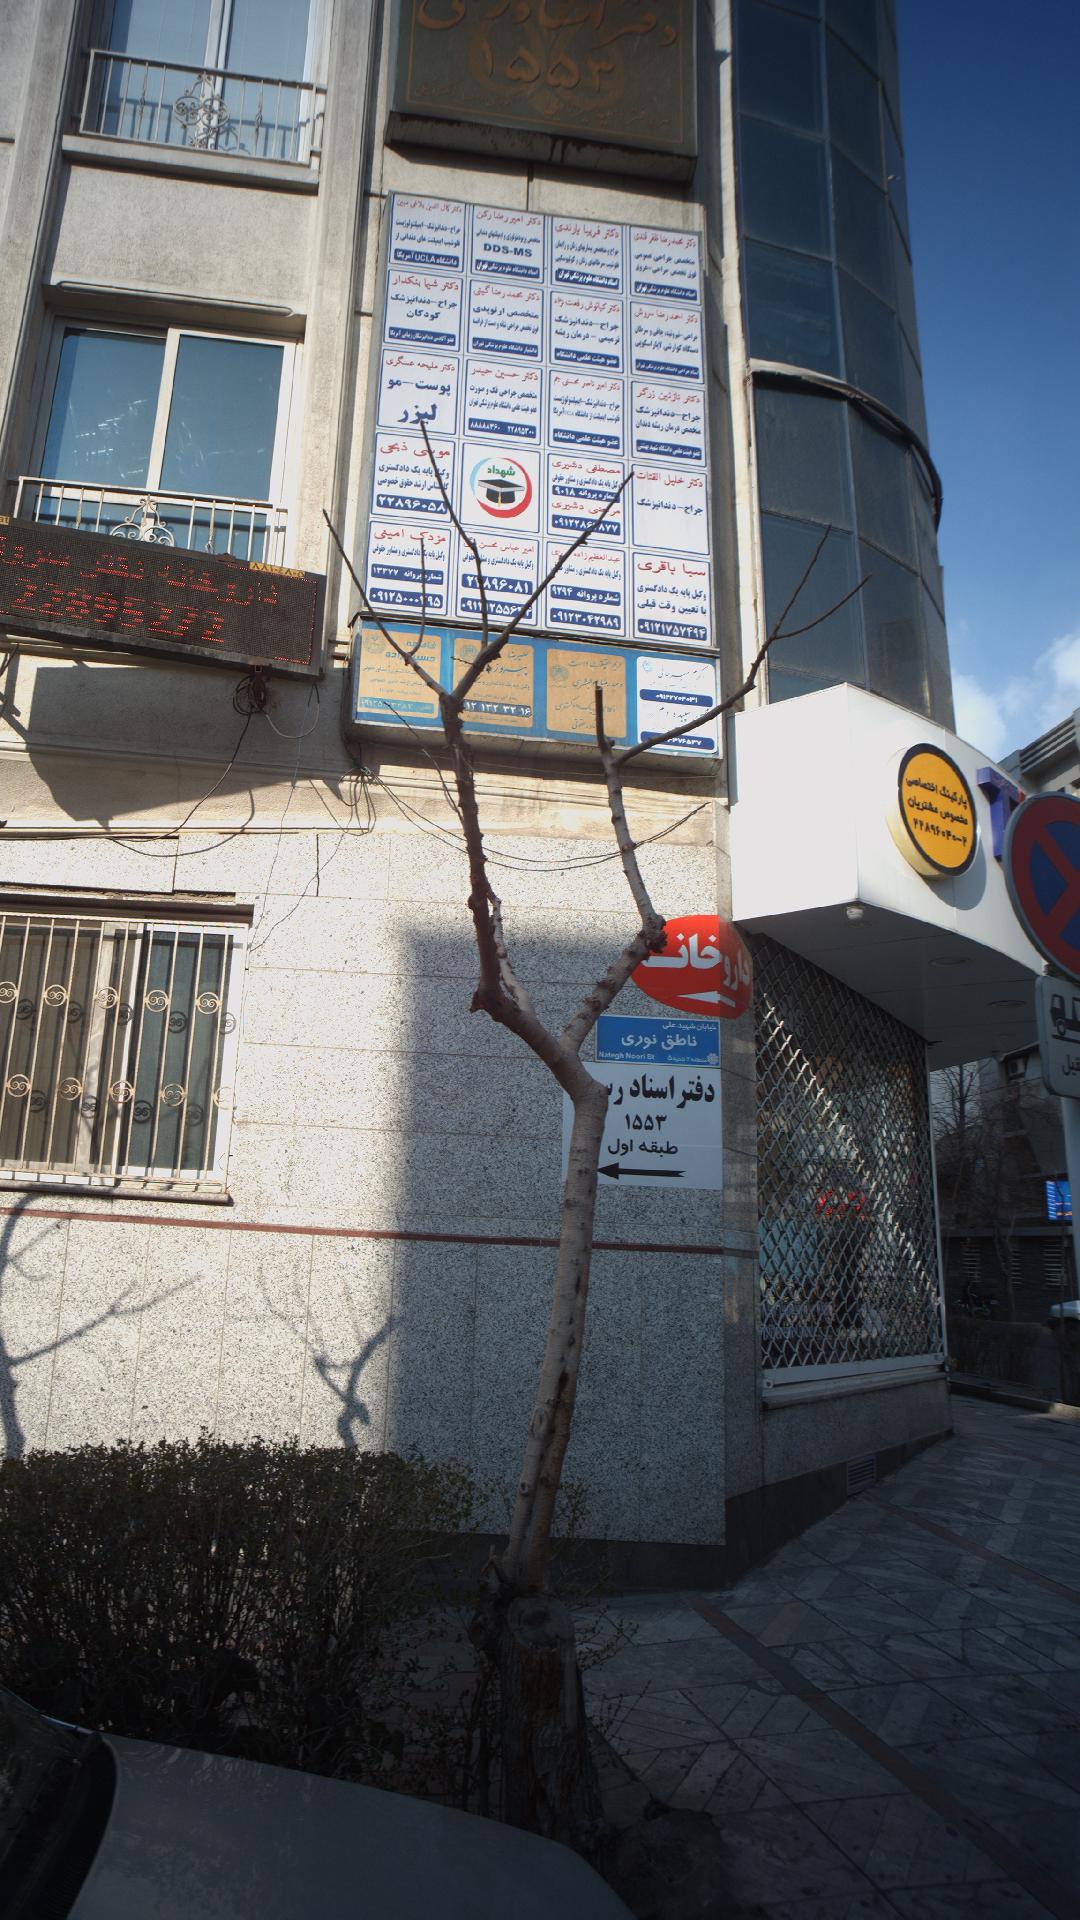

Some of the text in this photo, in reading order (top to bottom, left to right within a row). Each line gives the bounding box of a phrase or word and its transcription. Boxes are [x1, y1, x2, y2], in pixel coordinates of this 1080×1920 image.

[483, 243, 532, 256] DDS-MS
[441, 281, 458, 291] دکتر
[406, 309, 440, 320] کودکان
[440, 363, 455, 372] دکتر
[495, 369, 519, 379] حسین
[521, 371, 538, 381] دکتر
[397, 402, 437, 426] لیزر
[553, 431, 575, 439] دانشگاه
[378, 463, 433, 477] پایه یک دادگستری
[487, 465, 515, 477] شهداد
[585, 464, 621, 473] مصطفی
[686, 478, 703, 488] دکتر
[554, 486, 575, 497] ۹۰۱۸
[378, 496, 445, 511] ۲۲۸۹۶۰۵۸
[554, 517, 617, 531] ۰۹۱۲۲۸۶۸۷۷
[374, 529, 446, 544] مزدک امینی
[637, 561, 675, 574] باقری
[576, 590, 597, 601] پروانه
[598, 593, 619, 602] شماره
[637, 584, 706, 600] وکیل پایه یک دادگستری
[637, 599, 706, 615] با تعیین وقت قبلی
[639, 622, 705, 638] ۰۹۱۲۱۷۵۷۴۹۴
[520, 707, 530, 715] ۱۶
[940, 786, 968, 811] پارکینگ
[907, 796, 968, 826] مخصوص مشتریان
[621, 1033, 697, 1051] ناطق نوری
[629, 1073, 715, 1109] دفتر اسناد
[625, 1113, 668, 1131] ۱۵۵۳
[607, 1138, 679, 1158] طبقه اول
